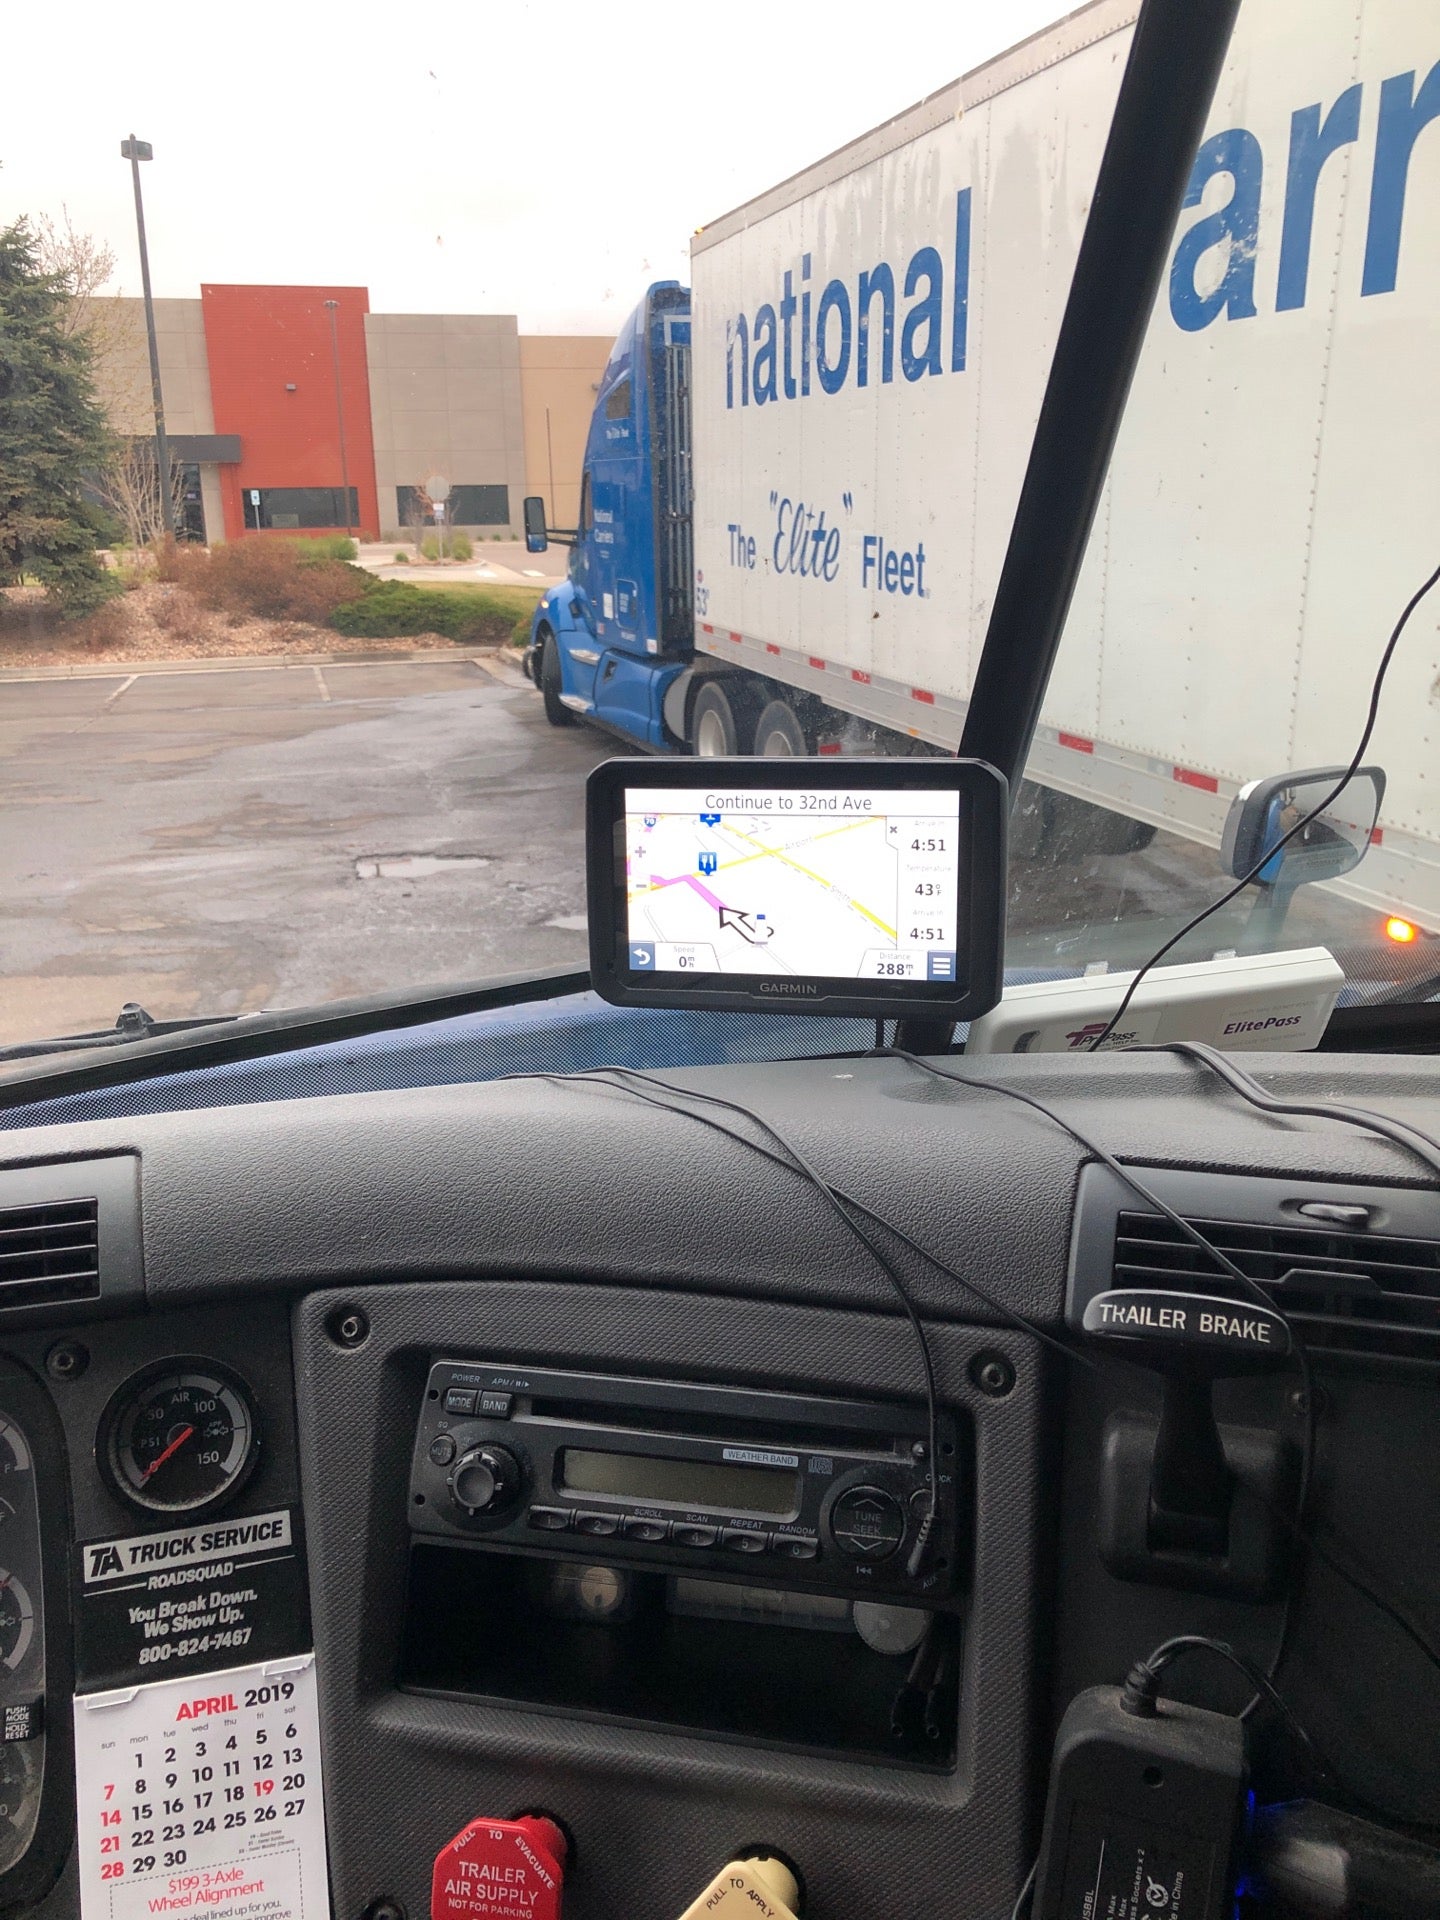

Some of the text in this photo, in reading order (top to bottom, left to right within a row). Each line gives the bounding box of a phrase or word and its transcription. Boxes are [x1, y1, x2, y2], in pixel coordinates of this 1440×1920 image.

[725, 58, 1440, 410] national arr
[728, 524, 756, 570] The
[862, 535, 926, 598] Fleet
[705, 795, 872, 810] Continue to 32nd Ave
[911, 838, 946, 851] 4:51
[910, 928, 945, 940] 4:51
[673, 946, 695, 954] Speed
[879, 952, 911, 960] Distance
[759, 982, 817, 994] GARMIN
[1223, 1016, 1302, 1035] ElitePass
[1079, 1031, 1137, 1046] PrPass
[1099, 1304, 1272, 1344] TRAILER BRAKE
[451, 1373, 481, 1383] POWER
[171, 1391, 190, 1404] AIR
[194, 1399, 216, 1414] 100
[447, 1396, 508, 1411] MODE BAND
[147, 1408, 164, 1420] 50
[140, 1437, 160, 1448] PSI
[431, 1447, 452, 1456] MUTE
[197, 1450, 219, 1464] 150
[728, 1450, 794, 1465] WEATHER BAND
[634, 1508, 816, 1535] SCROLL SCAN REPEAT RANDOM
[855, 1510, 881, 1523] TUNE
[594, 1520, 601, 1531] 2
[643, 1526, 650, 1537] 3
[692, 1532, 699, 1543] 4
[741, 1538, 749, 1549] 5
[792, 1544, 800, 1555] 6
[853, 1524, 881, 1535] SEEK
[90, 1519, 283, 1577] TA TRUCK SERVICE
[147, 1562, 234, 1590] ROADSQUAD
[922, 1575, 938, 1589] AUX
[129, 1589, 258, 1624] You Break Down.
[144, 1607, 244, 1638] We Show Up.
[138, 1628, 252, 1665] 800-824-7467
[175, 1682, 295, 1721] APRIL 2019
[6, 1713, 30, 1722] MODE
[101, 1741, 116, 1750] sun
[130, 1734, 149, 1744] mon
[163, 1730, 176, 1738] tue
[192, 1723, 209, 1733] wed
[284, 1706, 296, 1714] sat
[5, 1731, 30, 1740] RESET
[135, 1723, 297, 1769] 1 2 3 4 5 6
[104, 1748, 303, 1800] 7 8 9 10 11 12 13
[100, 1773, 305, 1827] 14 15 16 17 18 19 20
[100, 1799, 306, 1853] 21 22 23 24 25 26 27
[101, 1849, 187, 1880] 28 29 30
[453, 1829, 555, 1890] PULL TO EVACUATE
[168, 1867, 244, 1894] $199 3-Axle
[459, 1861, 526, 1885] TRAILER
[1131, 1866, 1143, 1904] Sockets
[1137, 1848, 1145, 1856] 2
[148, 1879, 265, 1913] Wheel Alignment
[444, 1879, 539, 1906] AIR SUPPLY
[1172, 1872, 1184, 1900] China
[448, 1897, 533, 1919] NOT FOR PARKING
[706, 1878, 775, 1918] PULL TO APPLY
[1107, 1895, 1118, 1914] Max
[1118, 1898, 1128, 1918] Max
[1170, 1902, 1180, 1911] in
[210, 1906, 233, 1919] lined
[234, 1906, 248, 1917] up
[249, 1902, 261, 1913] for
[263, 1899, 282, 1912] you.
